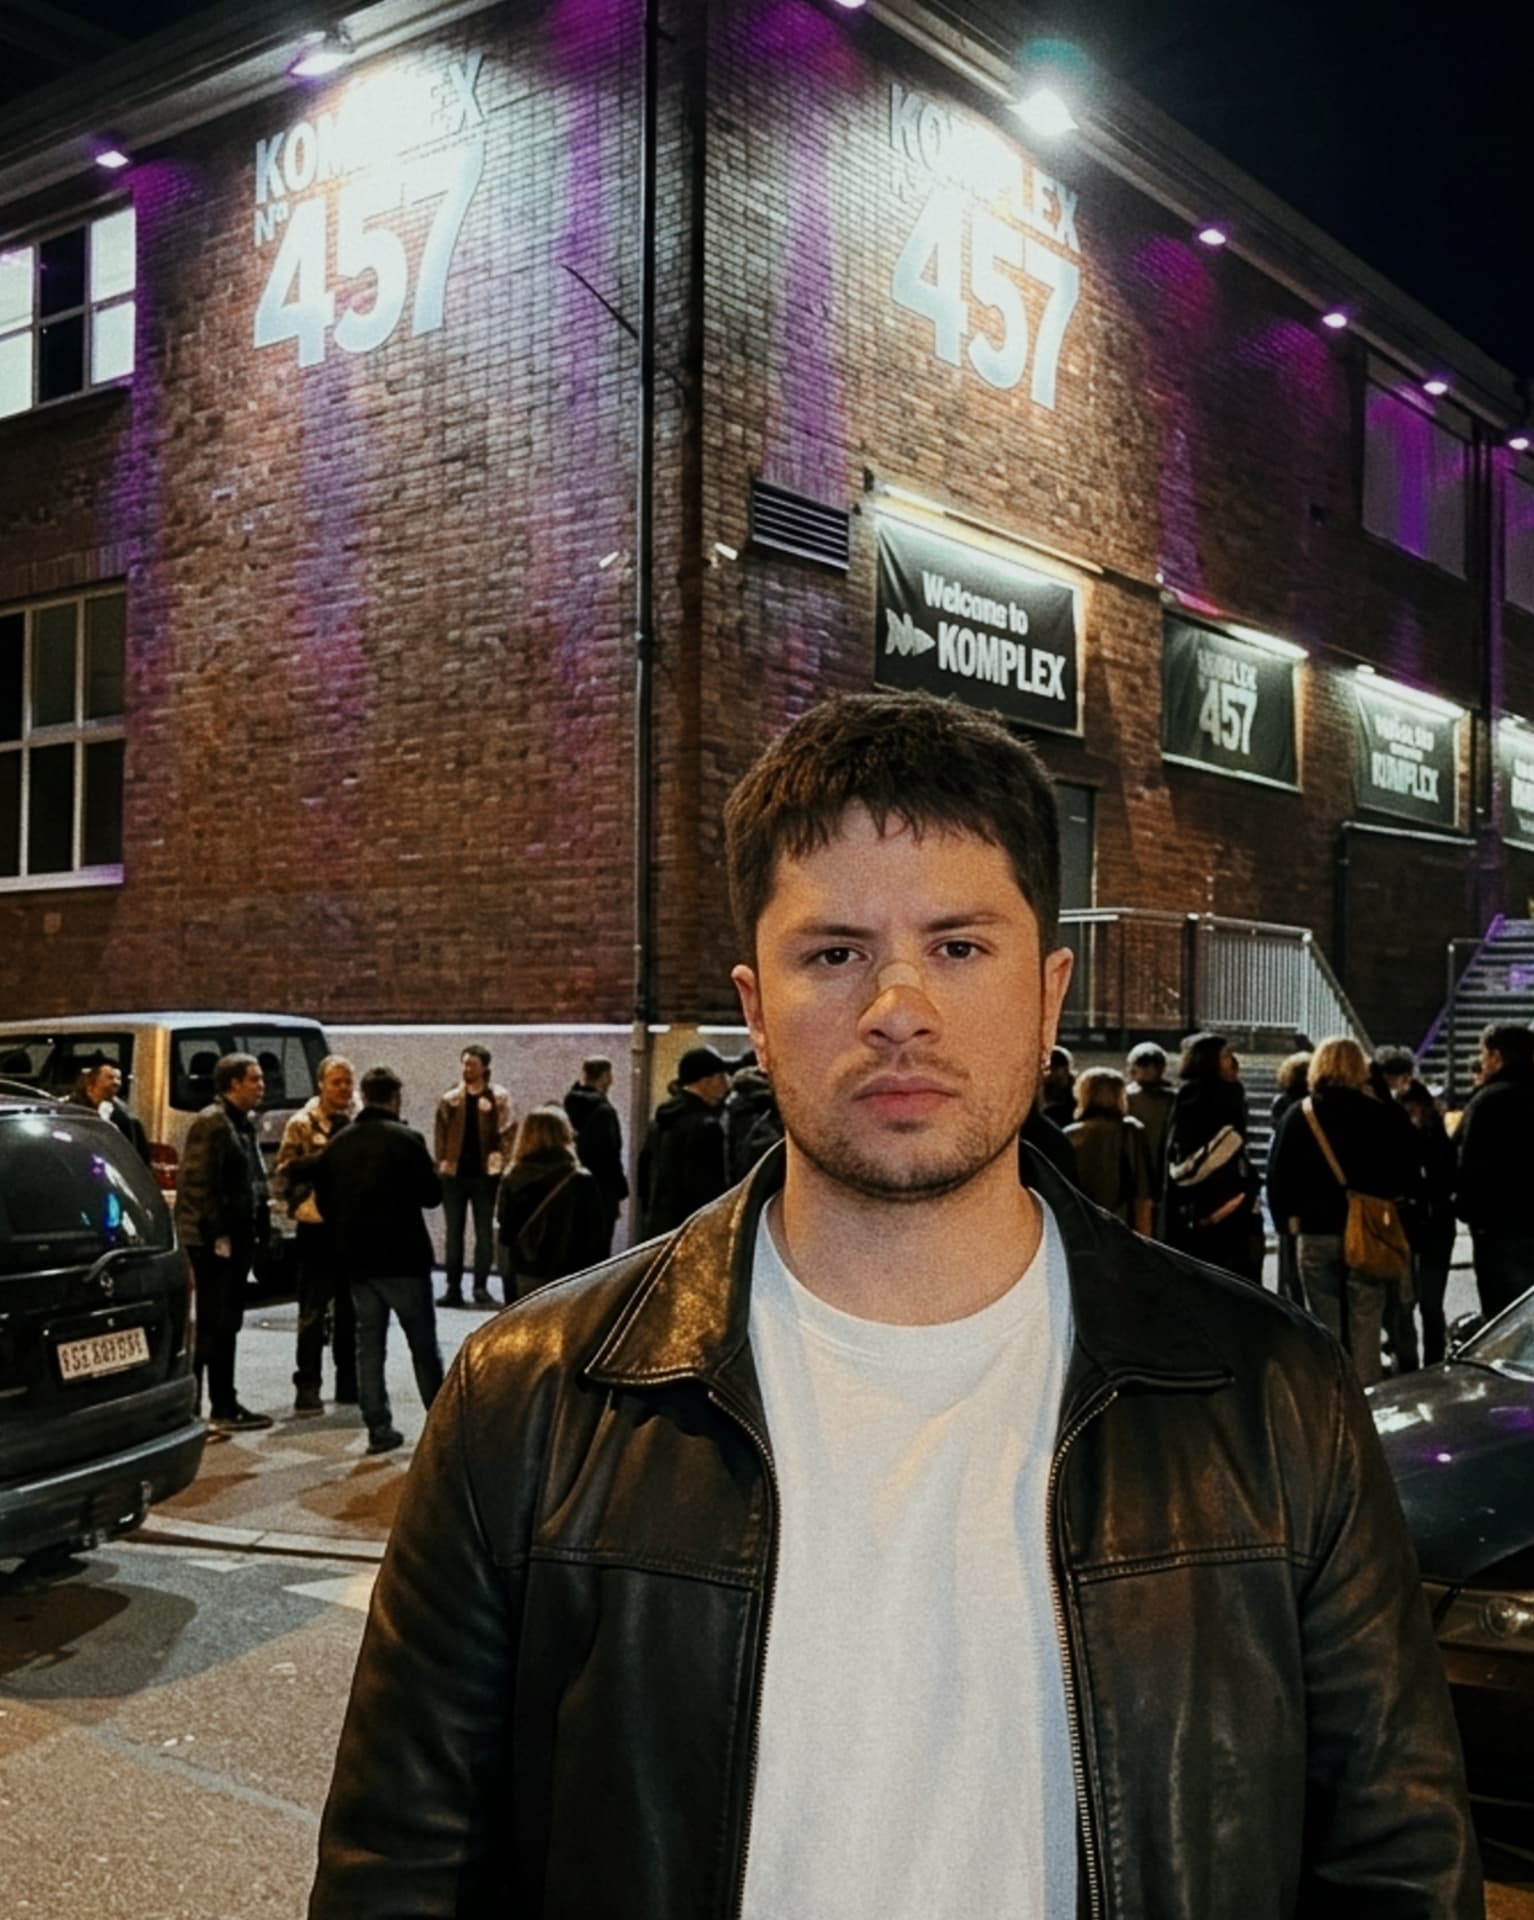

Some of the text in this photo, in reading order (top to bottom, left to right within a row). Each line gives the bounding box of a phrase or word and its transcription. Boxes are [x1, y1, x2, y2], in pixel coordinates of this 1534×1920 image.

[253, 135, 486, 369] 457
[892, 187, 1081, 411] 457
[938, 620, 1066, 701] KOMPLEX
[1200, 679, 1258, 755] 457
